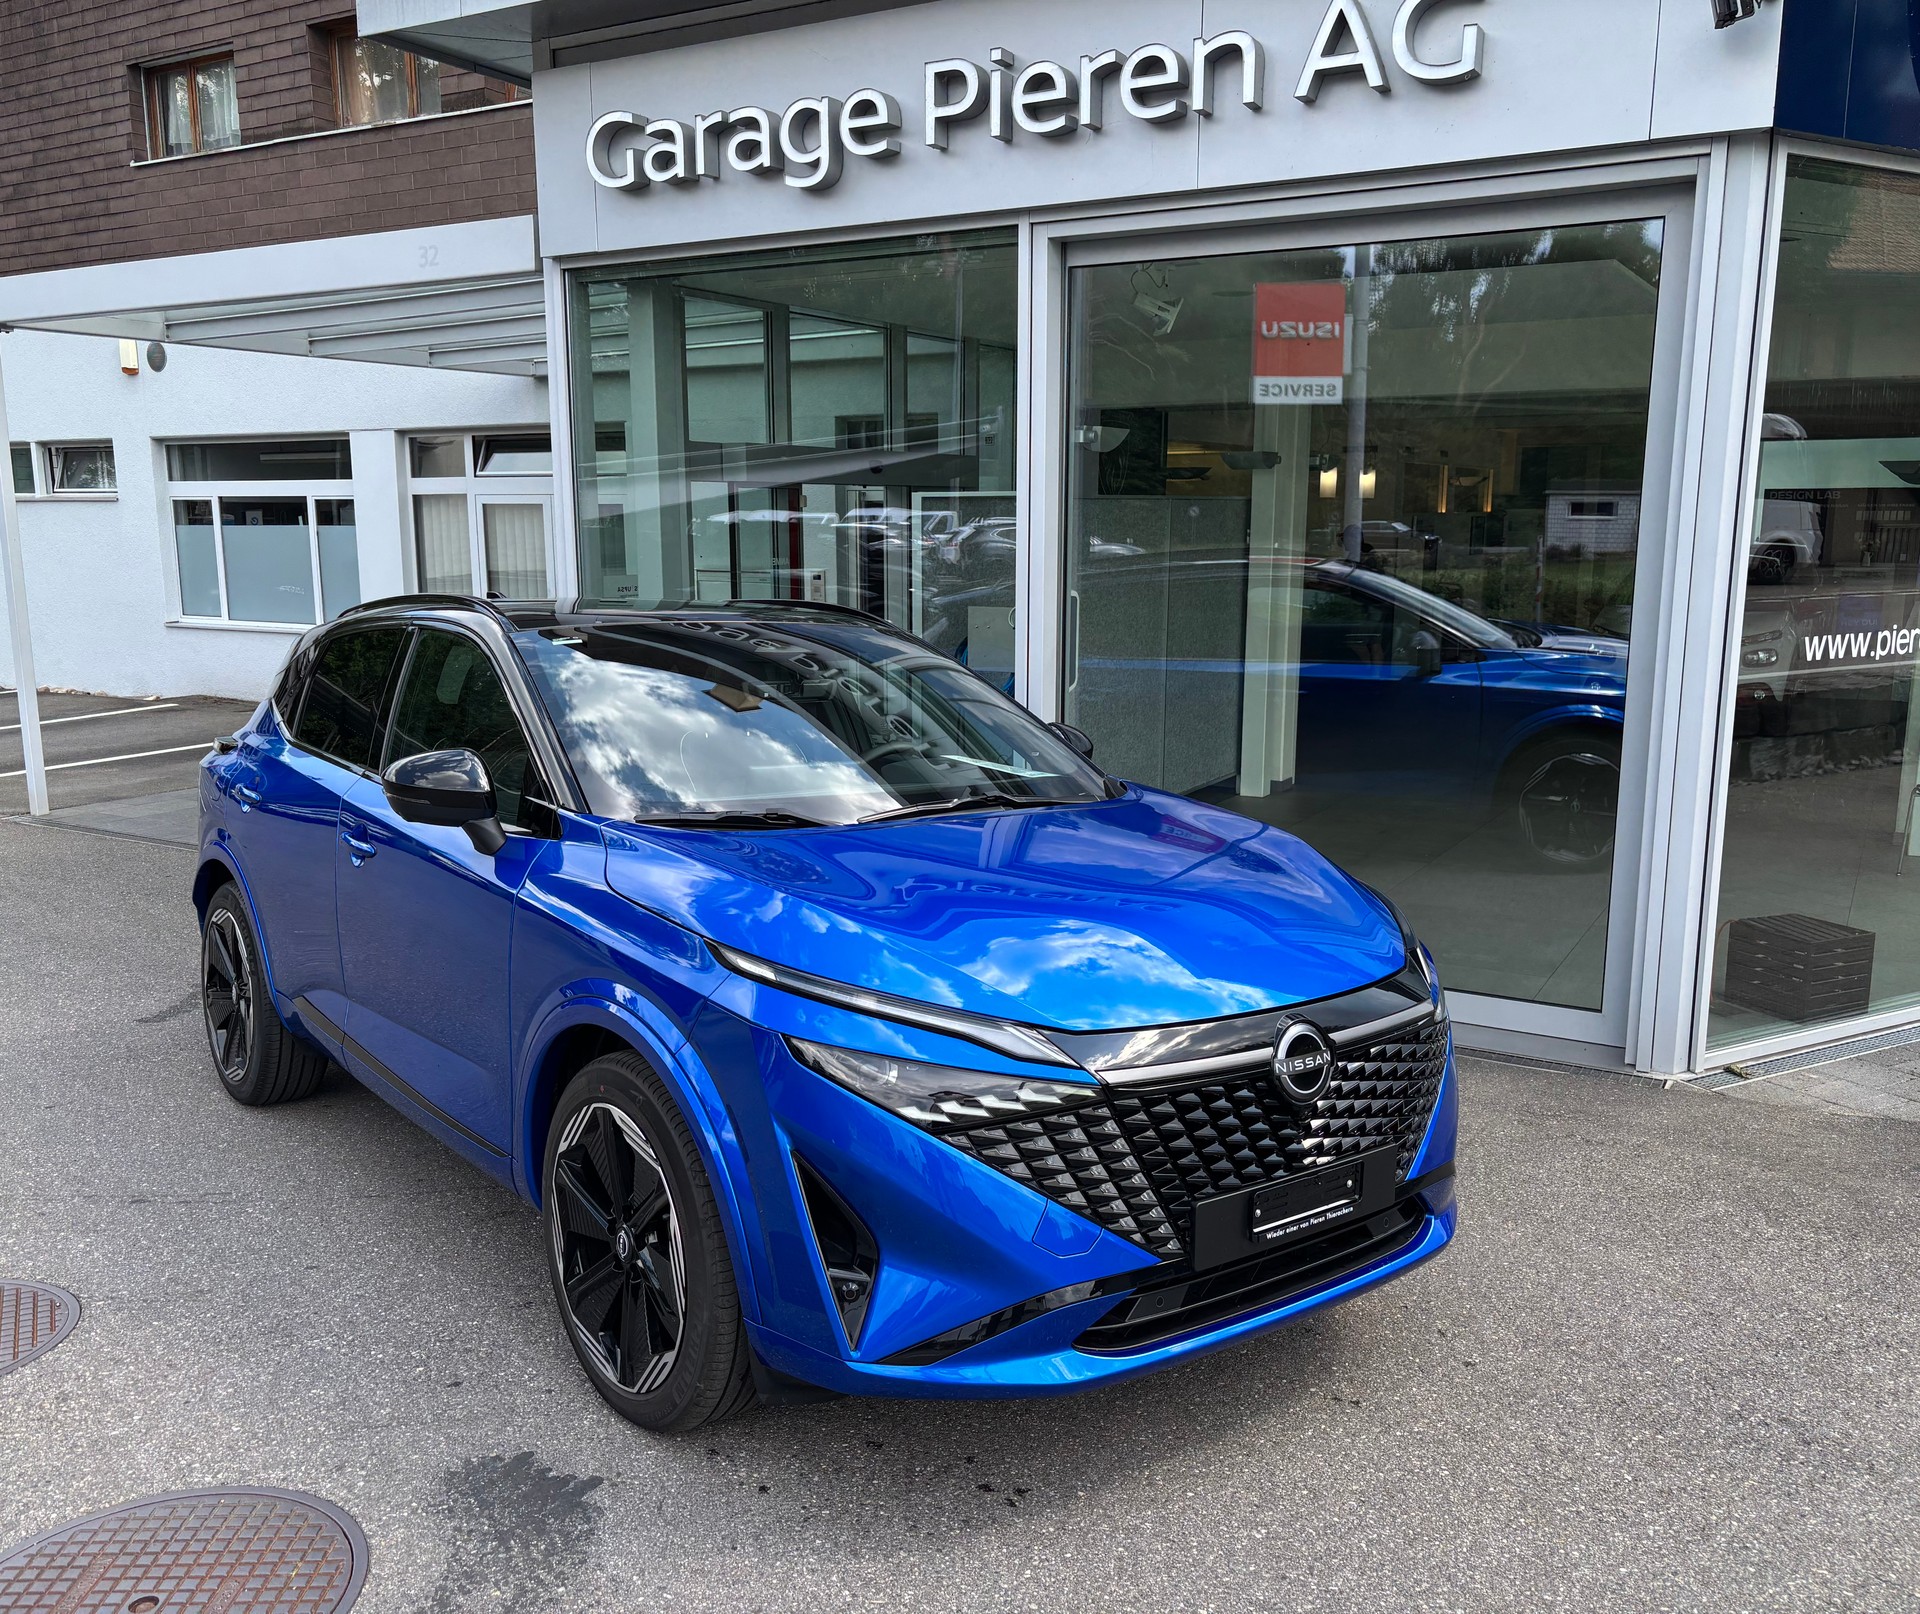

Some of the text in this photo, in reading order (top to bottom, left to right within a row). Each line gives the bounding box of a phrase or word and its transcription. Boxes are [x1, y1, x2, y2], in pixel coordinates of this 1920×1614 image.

[586, 0, 1485, 190] Garage Pieren AG
[418, 244, 440, 268] 32
[1770, 490, 1841, 501] DESIGN LAB
[1275, 1051, 1331, 1074] NISSAN
[1266, 1229, 1286, 1240] Wieder
[1286, 1225, 1299, 1233] einer
[1310, 1217, 1326, 1226] Pieren
